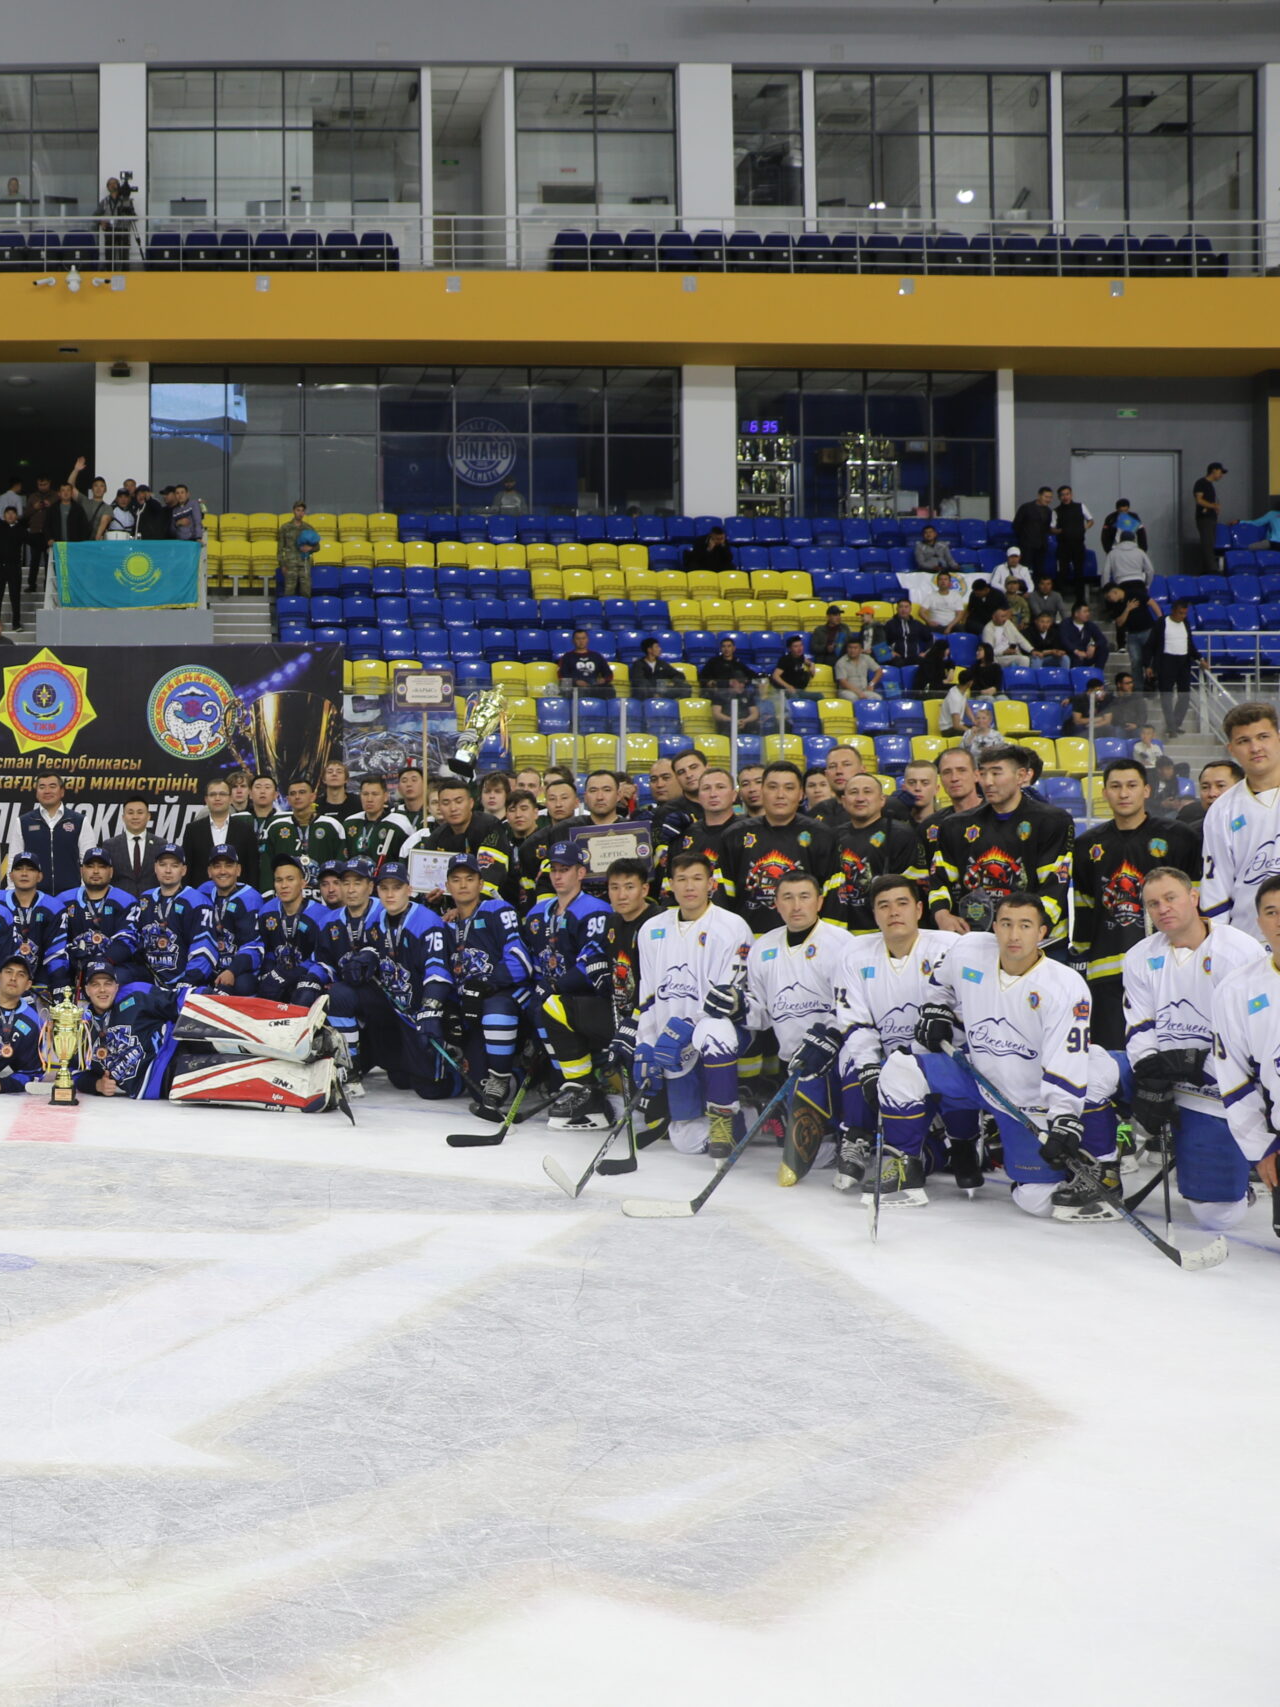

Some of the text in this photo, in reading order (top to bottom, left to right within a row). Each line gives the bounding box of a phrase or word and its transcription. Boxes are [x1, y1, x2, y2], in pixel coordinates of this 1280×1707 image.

[455, 440, 509, 460] DINAMO
[36, 754, 142, 772] Республикасы
[90, 773, 198, 794] министрінің
[425, 932, 443, 952] 76
[974, 1025, 1027, 1051] Өскемен
